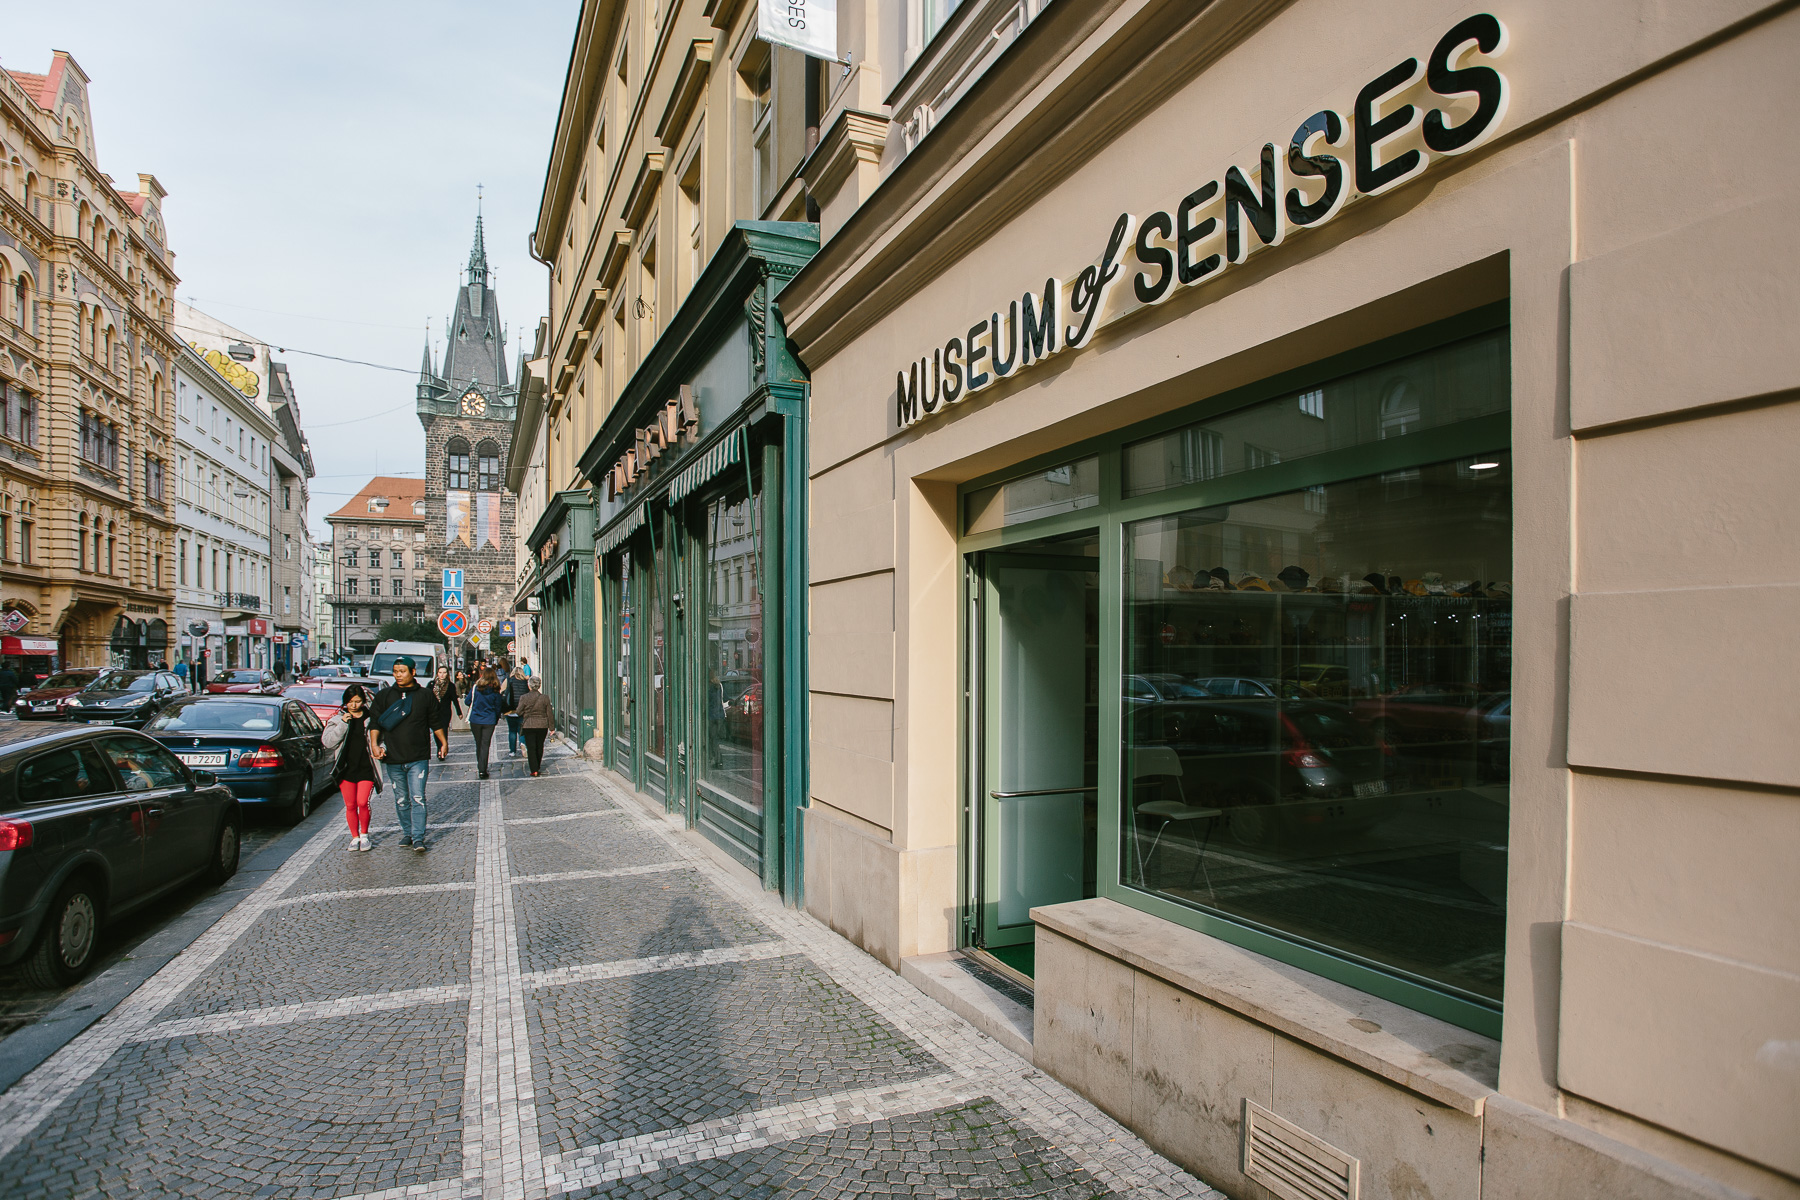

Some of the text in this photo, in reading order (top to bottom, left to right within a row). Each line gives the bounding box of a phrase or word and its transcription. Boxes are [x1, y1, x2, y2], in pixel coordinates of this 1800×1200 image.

[897, 13, 1505, 428] MUSEUM of SENSES
[198, 755, 222, 764] 7270
